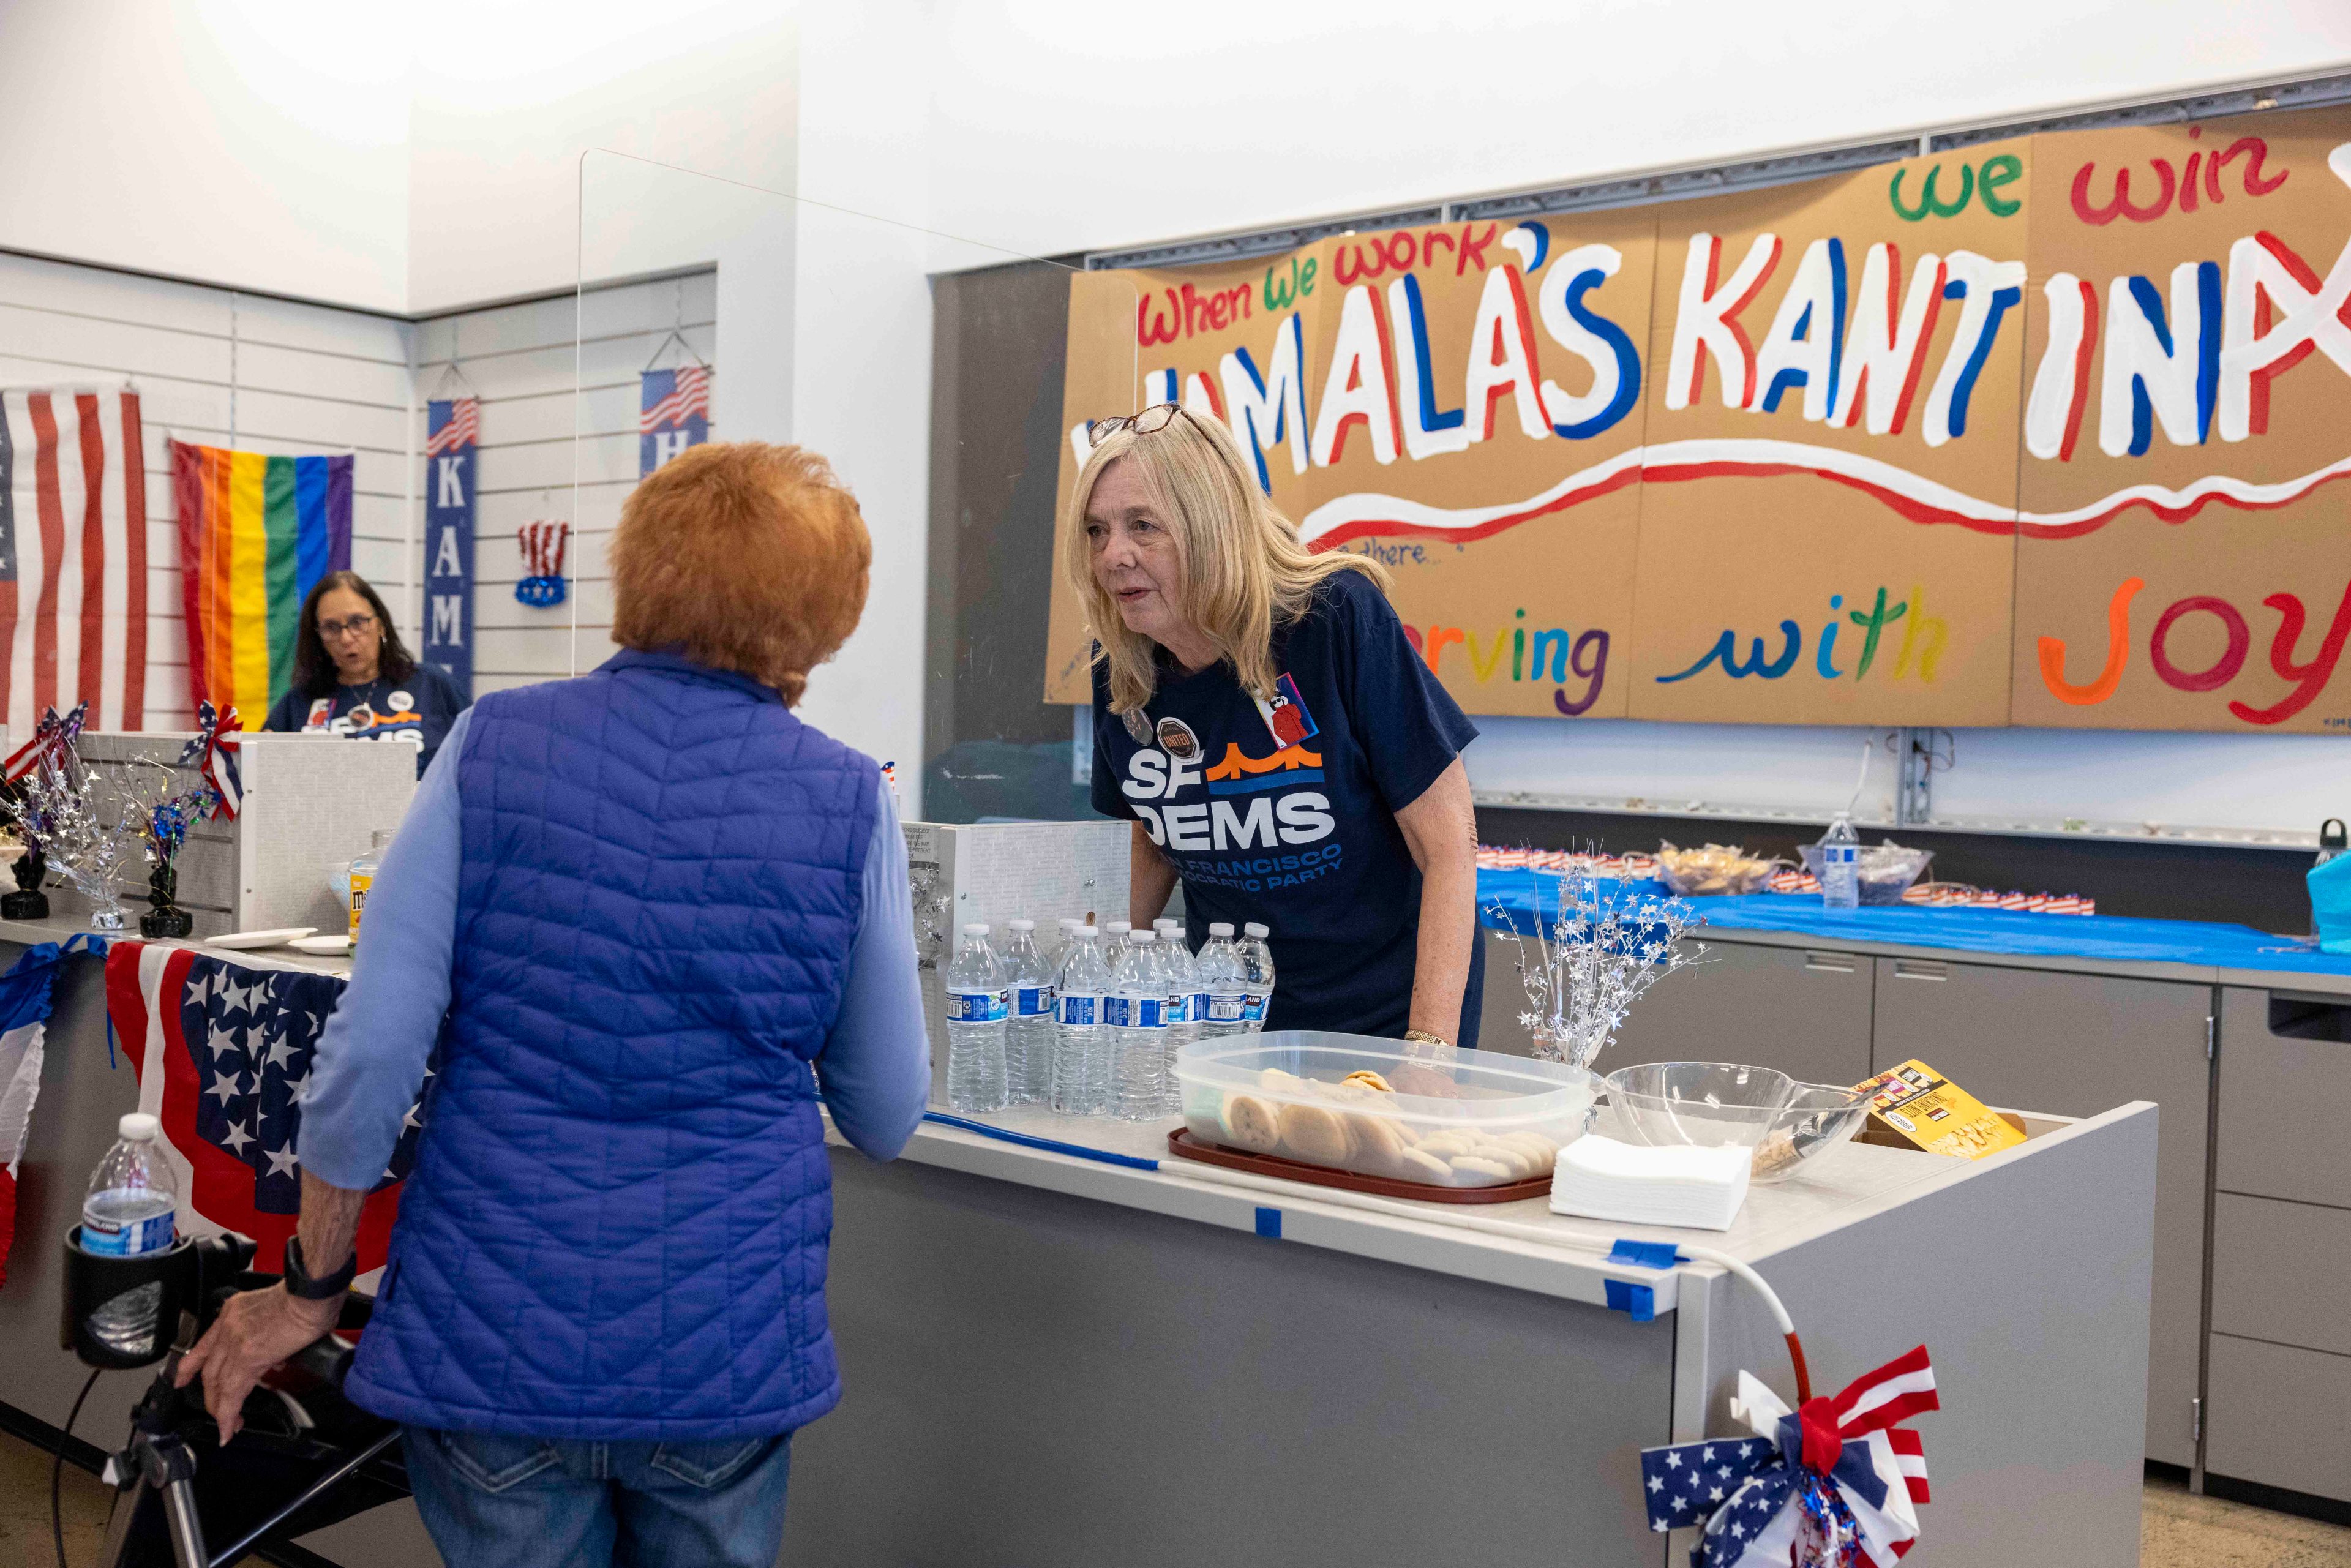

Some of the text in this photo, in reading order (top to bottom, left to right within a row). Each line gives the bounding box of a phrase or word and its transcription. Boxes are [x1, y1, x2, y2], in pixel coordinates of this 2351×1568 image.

[1138, 283, 1251, 347] When
[1334, 222, 1498, 286] work
[1889, 154, 2023, 222] we
[2071, 127, 2290, 225] win
[1071, 222, 1641, 497] MALA'S
[1656, 584, 1949, 683] with
[1163, 733, 1190, 748] UNITED
[1122, 749, 1205, 799] SF
[1185, 843, 1342, 876] FRANCISCO
[1267, 857, 1344, 890] PARTY
